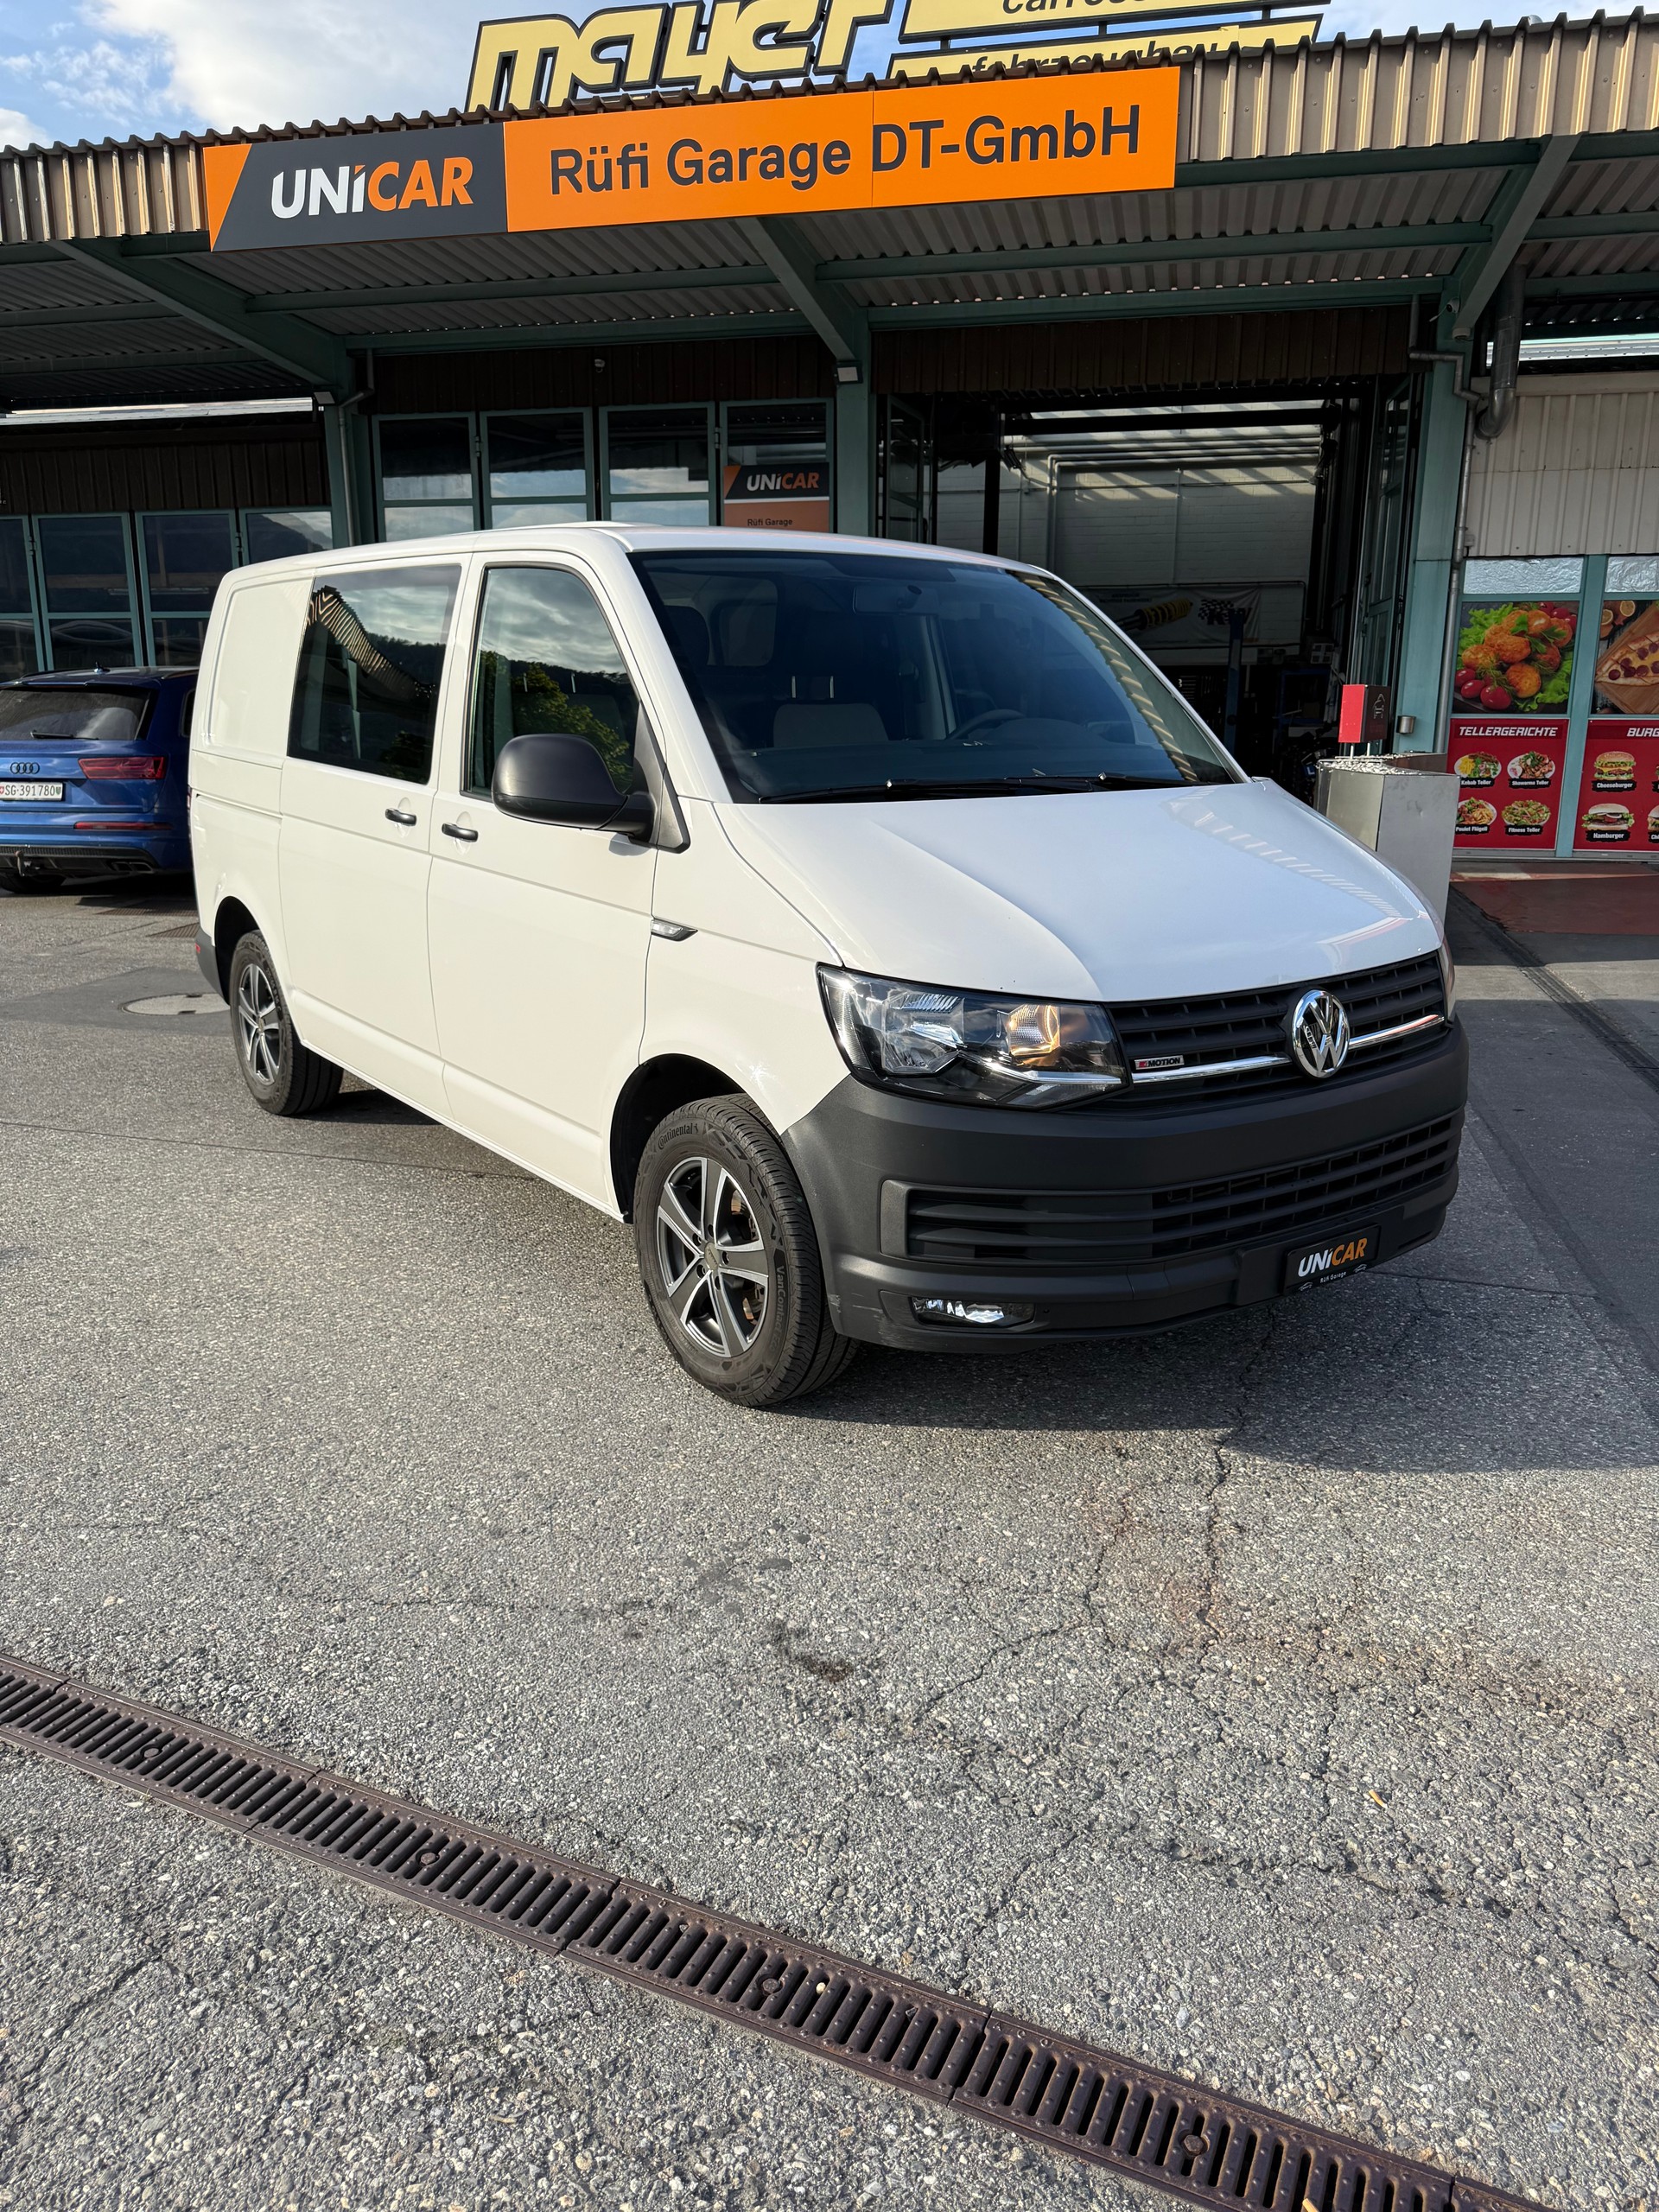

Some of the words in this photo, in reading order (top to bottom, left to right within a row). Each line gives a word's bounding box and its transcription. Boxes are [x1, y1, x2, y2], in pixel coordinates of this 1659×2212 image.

[550, 142, 650, 196] Rüfi
[666, 137, 852, 192] Garage
[872, 104, 1141, 173] DT-GmbH
[747, 518, 763, 527] Rüfi
[765, 518, 793, 528] Garage
[1459, 727, 1558, 737] TELLERGERICHTE
[658, 1123, 693, 1150] Continental
[1330, 1271, 1347, 1281] Garage
